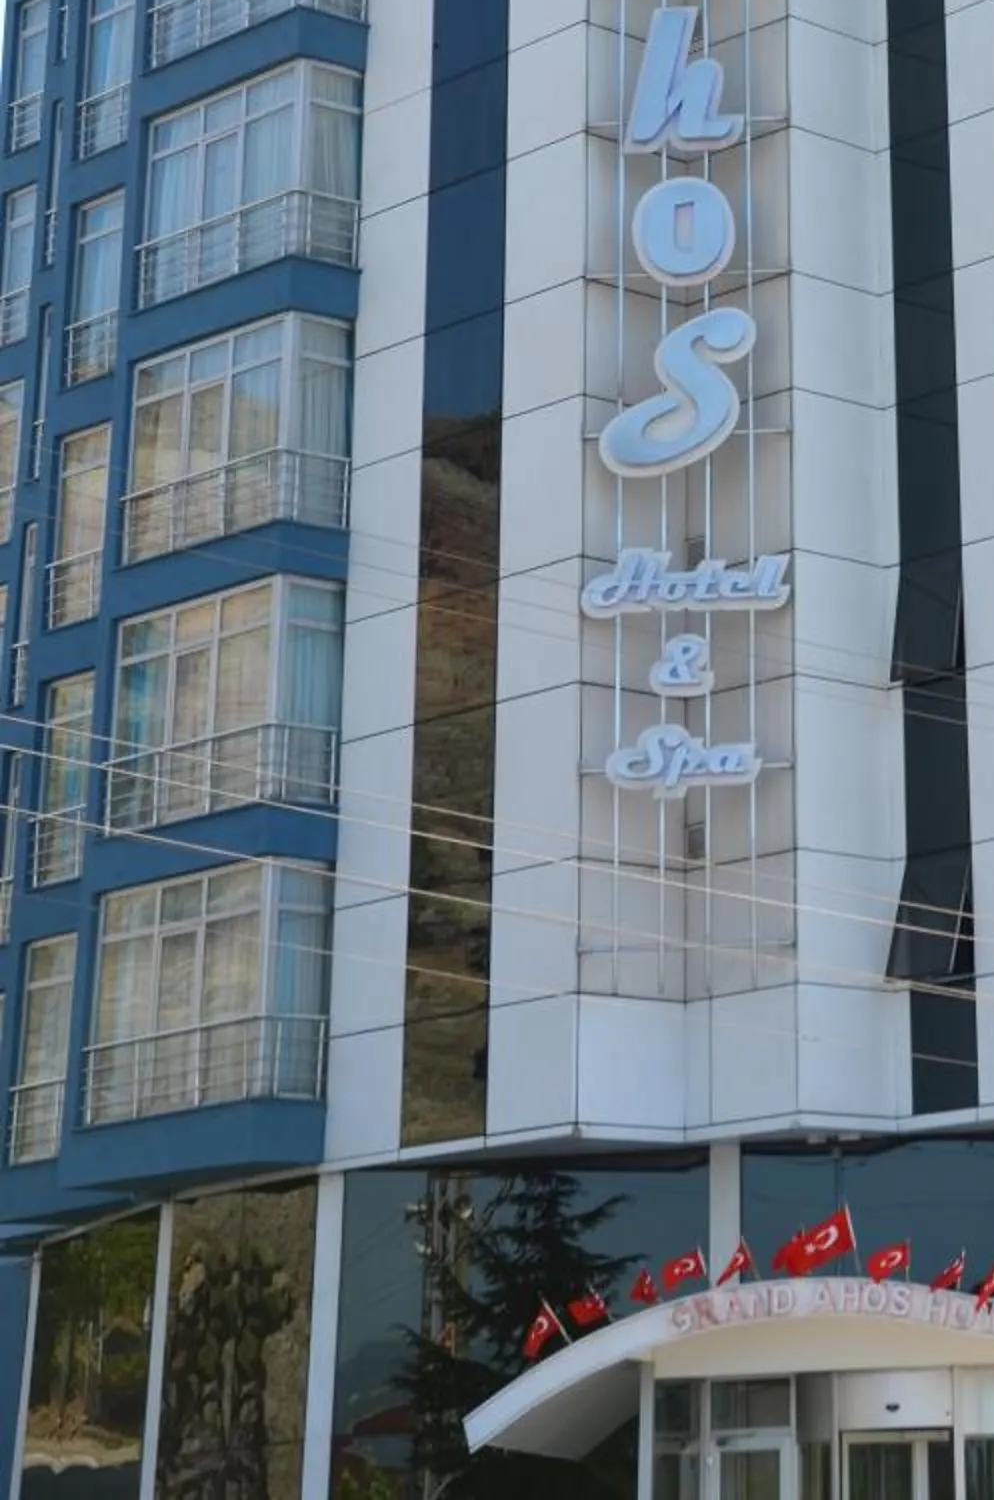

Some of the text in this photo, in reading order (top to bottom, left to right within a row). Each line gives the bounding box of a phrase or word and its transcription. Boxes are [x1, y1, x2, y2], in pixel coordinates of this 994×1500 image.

[583, 548, 790, 614] Hotel
[652, 634, 713, 695] &
[607, 725, 761, 796] Spa
[671, 1282, 797, 1332] GRAND
[813, 1278, 912, 1317] AHOS
